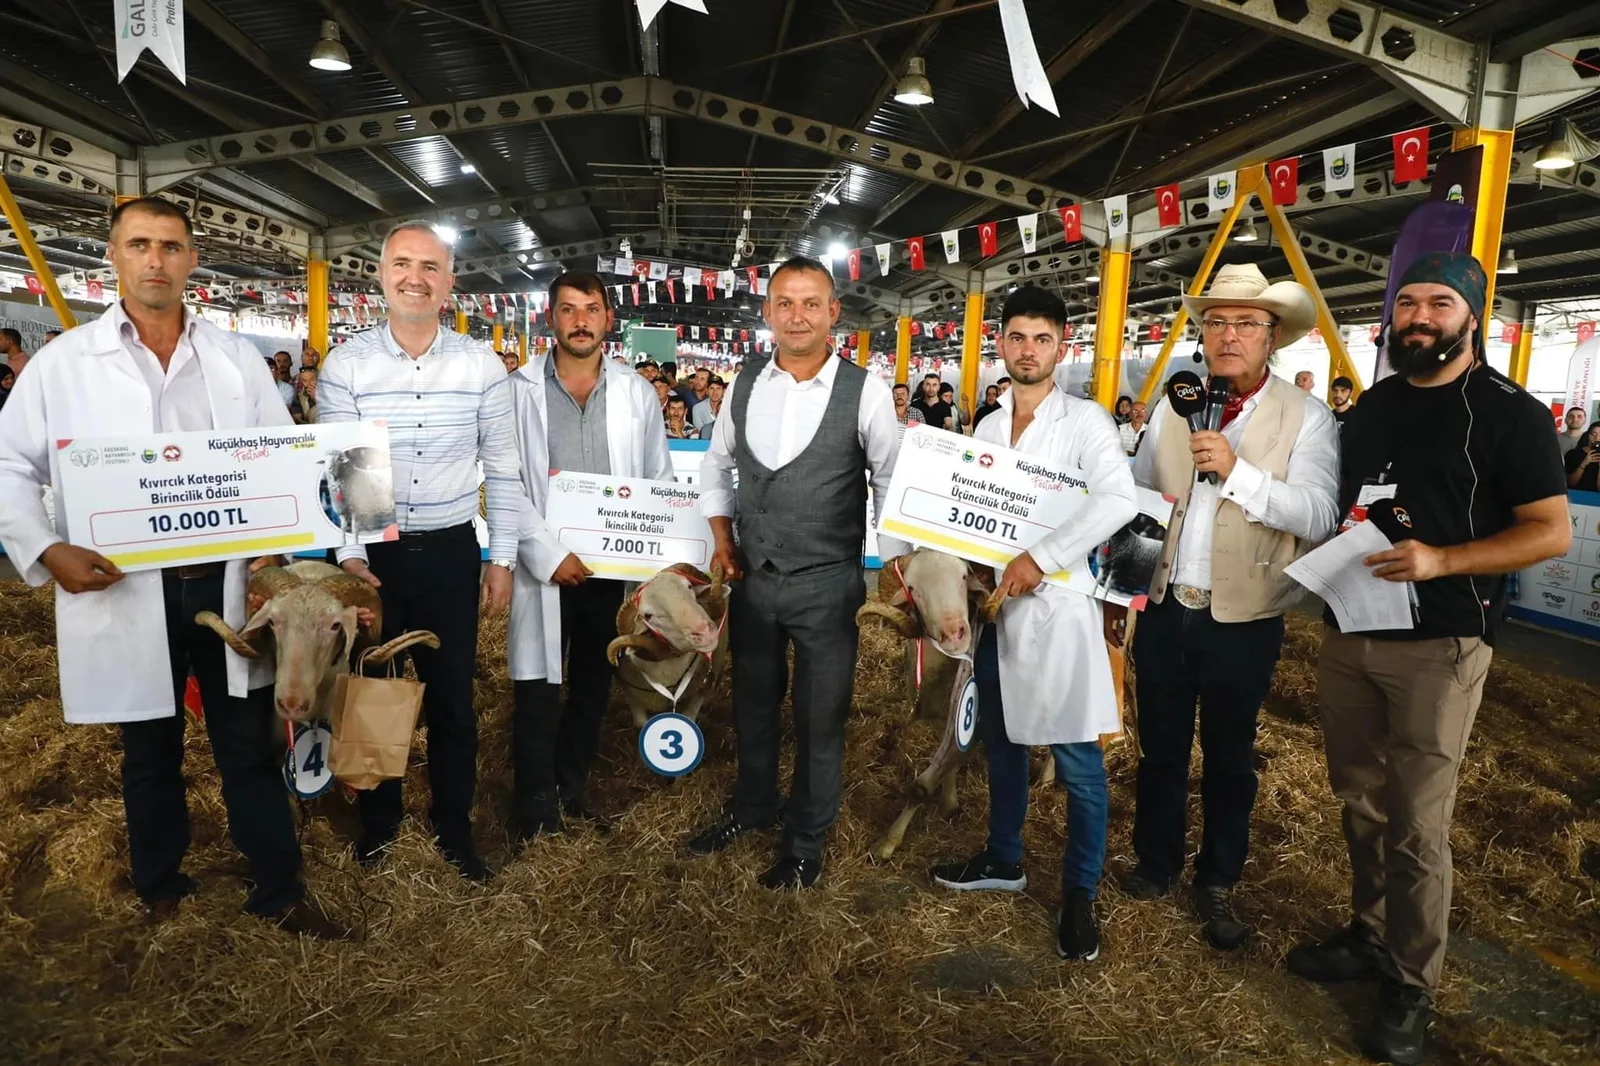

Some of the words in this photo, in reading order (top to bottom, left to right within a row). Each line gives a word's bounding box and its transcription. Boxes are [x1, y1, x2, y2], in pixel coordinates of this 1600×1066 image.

[208, 436, 259, 452] Küçükbaş
[259, 432, 316, 449] Hayvancılık
[139, 475, 186, 489] Kıvırcık
[187, 469, 247, 486] Kategorisi
[1016, 460, 1057, 482] Küçükbaş
[151, 489, 204, 504] Birincilik
[206, 486, 240, 500] Ödülü
[650, 486, 688, 500] Küçükbaş
[688, 490, 700, 499] Ha
[951, 472, 987, 491] Kıvırcık
[988, 483, 1038, 505] Kategorisi
[951, 485, 1000, 509] Üçüncülük
[1001, 500, 1030, 518] Ödülü
[148, 510, 220, 533] 10.000
[224, 507, 248, 525] TL
[597, 507, 630, 518] Kıvırcık
[631, 510, 675, 523] Kategorisi
[605, 518, 638, 532] İkincilik
[639, 521, 665, 534] Ödülü
[948, 507, 998, 533] 3.000
[1001, 521, 1018, 541] TL
[602, 537, 644, 554] 7.000
[647, 541, 664, 556] TL
[964, 696, 974, 731] 8
[659, 729, 684, 760] 3
[302, 742, 324, 777] 4
